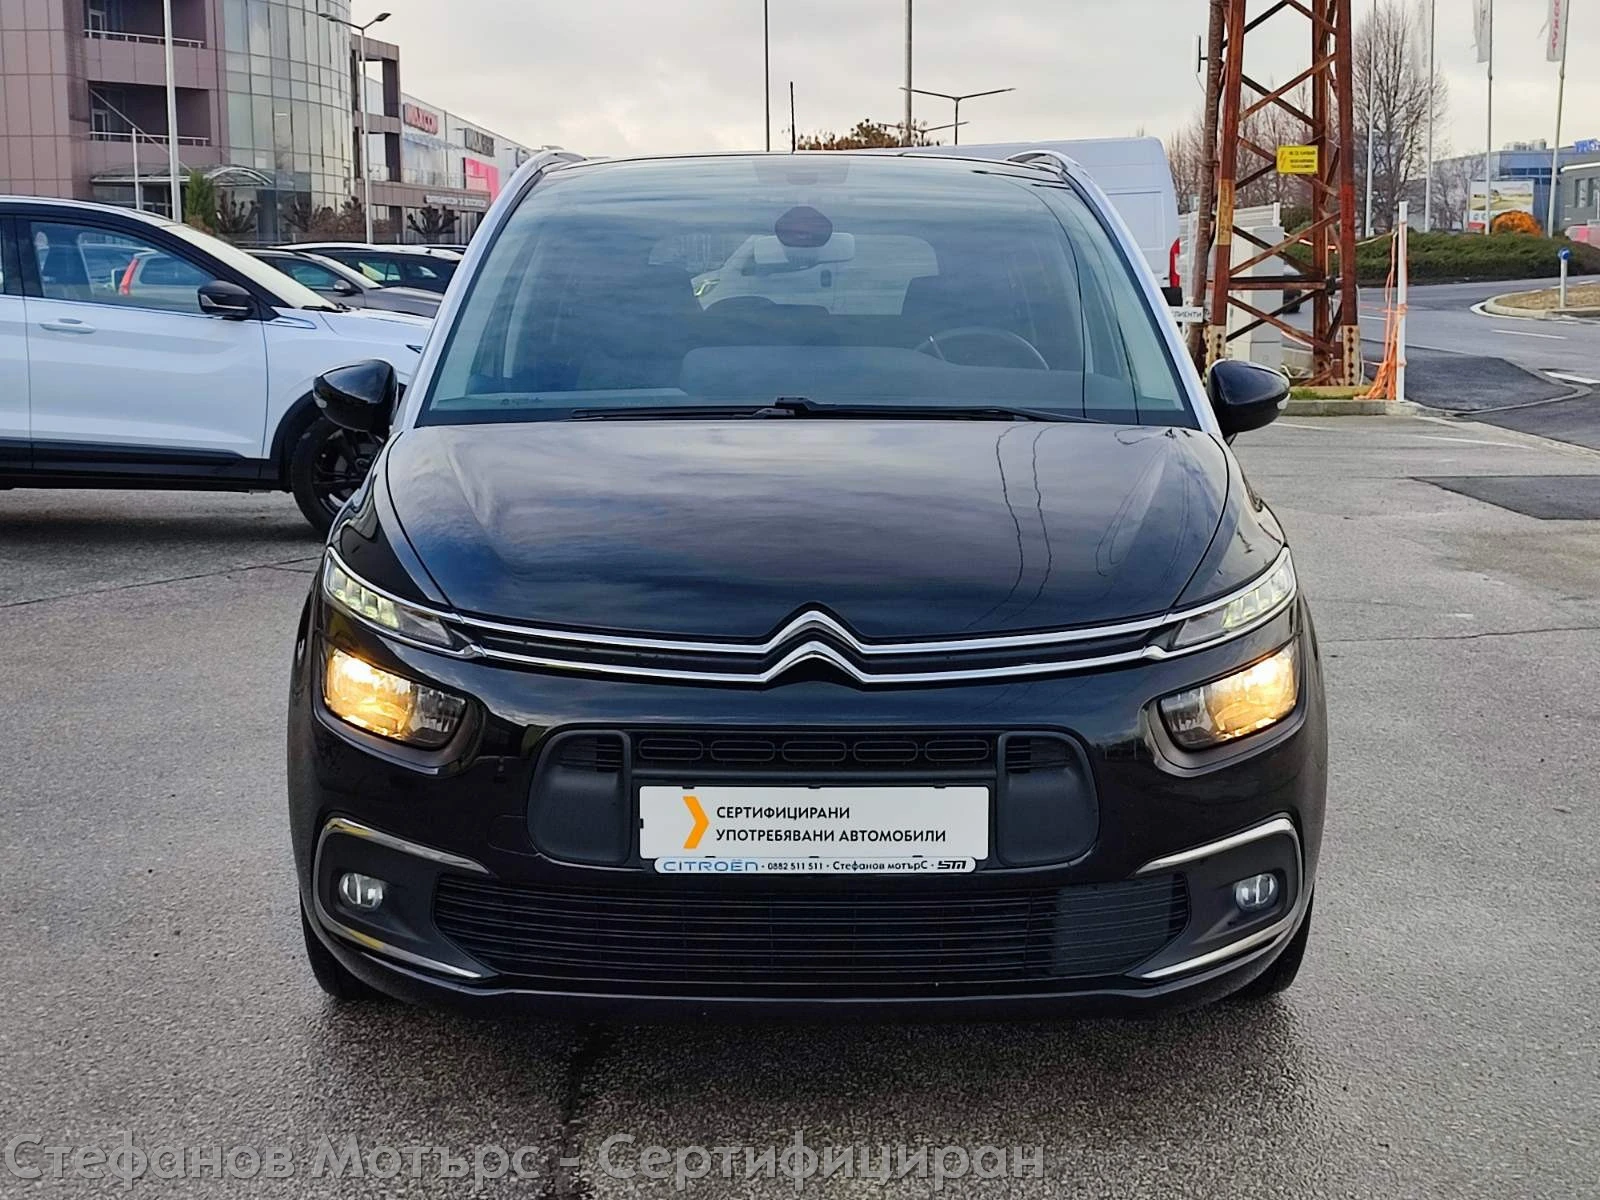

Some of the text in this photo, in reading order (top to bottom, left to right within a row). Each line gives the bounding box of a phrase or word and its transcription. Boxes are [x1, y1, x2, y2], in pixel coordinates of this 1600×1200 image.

[716, 806, 850, 820] СЕРТИФИЦИРАНИ
[716, 828, 946, 842] УПОТРЕБЯВАНИ АВТОМОБИЛИ
[767, 862, 787, 870] 0882
[790, 862, 805, 870] 511
[808, 862, 823, 870] 511
[832, 861, 885, 872] Стефанов
